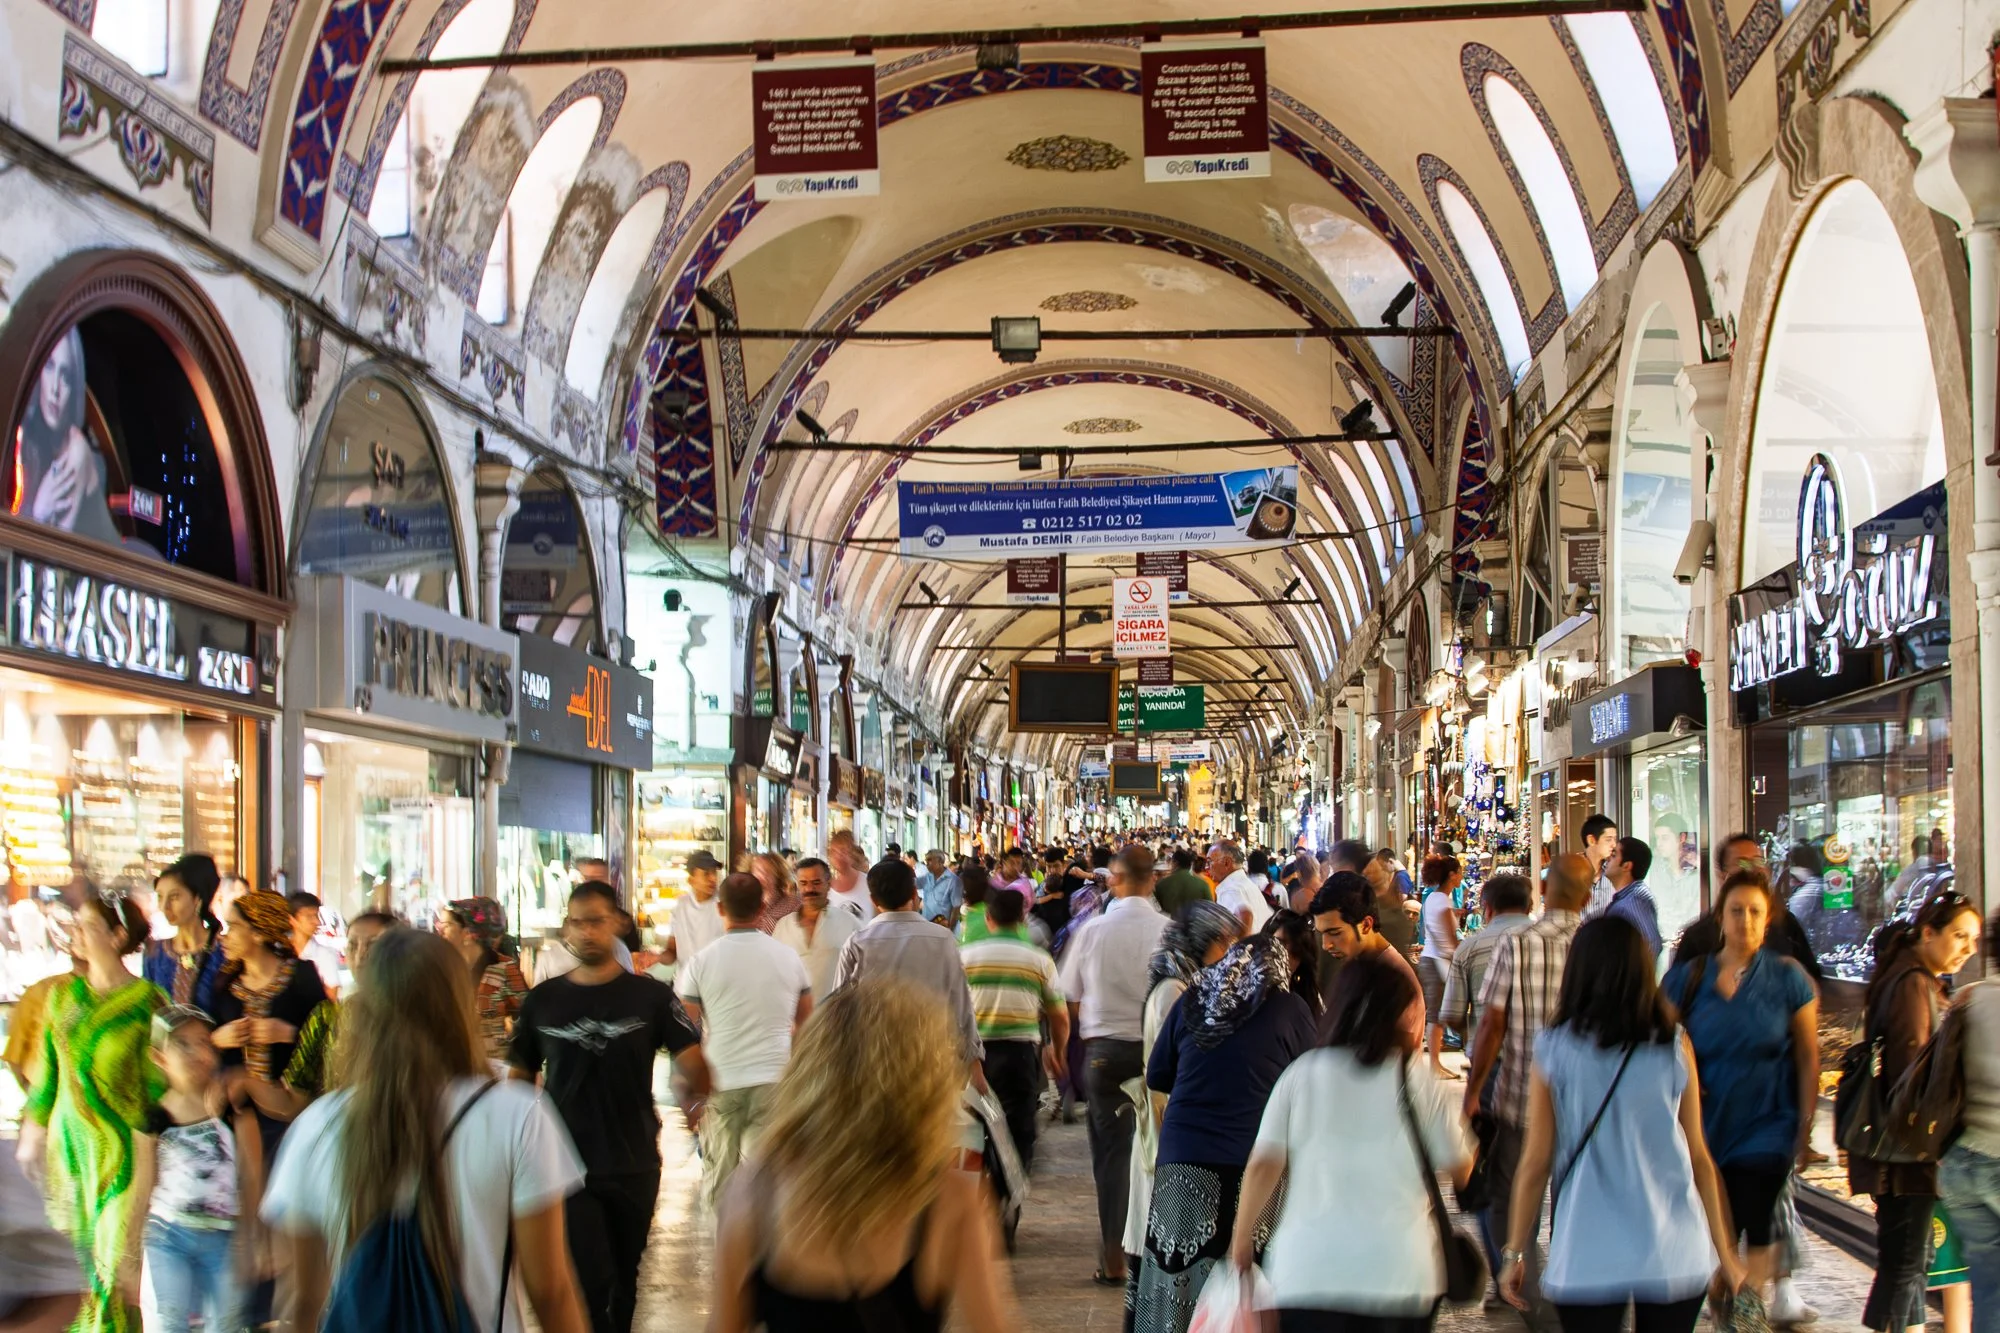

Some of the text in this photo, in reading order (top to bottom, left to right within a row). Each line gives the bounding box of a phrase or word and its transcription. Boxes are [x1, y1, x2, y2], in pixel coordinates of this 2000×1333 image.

[1161, 62, 1246, 74] Construction of the
[1157, 76, 1188, 85] Bazaar
[1190, 75, 1216, 84] began
[1219, 73, 1228, 81] in
[1154, 84, 1255, 96] and the oldest building
[1151, 95, 1258, 108] is the Cevahir Bedesten.
[1165, 107, 1246, 118] The second oldest
[1174, 118, 1237, 129] building is the
[1168, 129, 1244, 141] Sandal Bedesten.
[913, 484, 934, 495] Fatih
[937, 482, 987, 495] Municipality
[1119, 478, 1134, 487] and
[1136, 476, 1170, 489] requests
[1172, 476, 1197, 487] please
[1199, 475, 1216, 484] call.
[908, 494, 1218, 516] Tüm şikayet ve dilekleriniz için lütfen Fatih Belediyesi Şikayet Hattını arayınız.
[1042, 514, 1142, 529] 0212 517 02 02
[980, 536, 1028, 547] Mustafa
[1033, 533, 1073, 545] DEMİR
[1081, 533, 1101, 544] Fatih
[1104, 532, 1139, 544] Belediye
[1141, 532, 1175, 542] Başkanı
[1117, 618, 1164, 630] SİGARA
[1116, 630, 1167, 645] İÇİLMEZ
[366, 611, 513, 717] PRINCESS
[522, 669, 550, 701] RADO
[1145, 701, 1186, 710] YANINDA!
